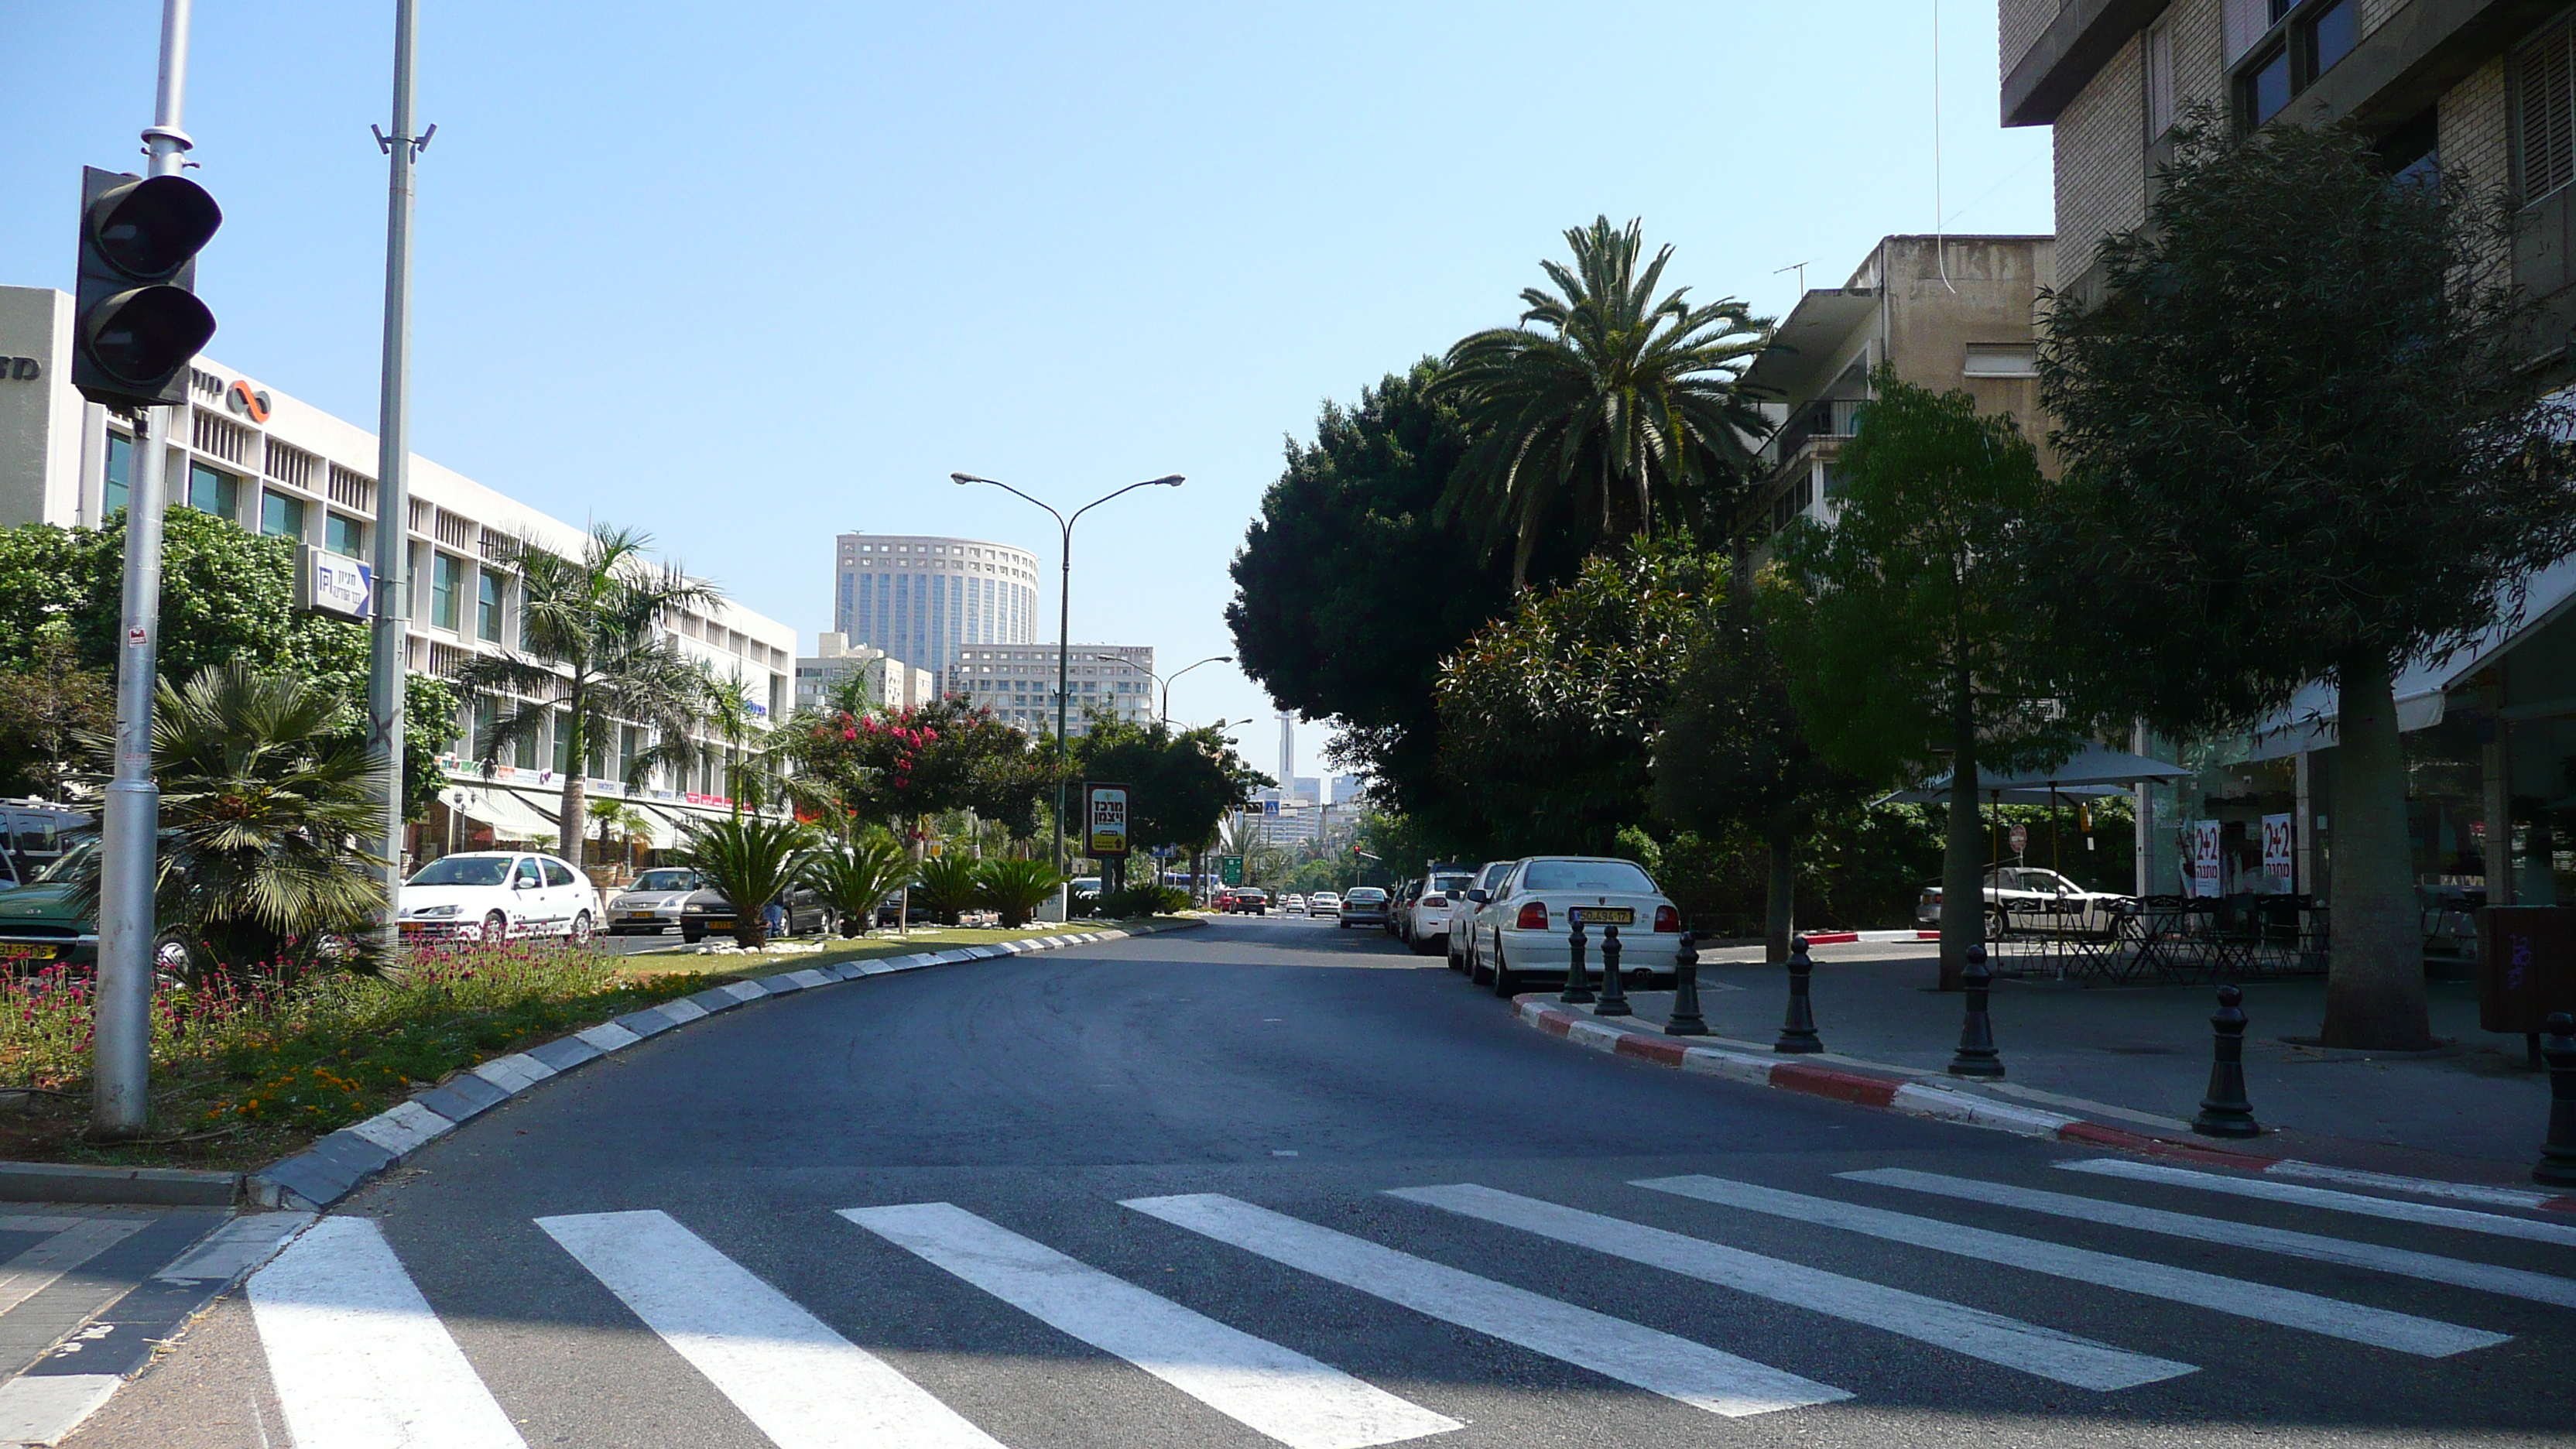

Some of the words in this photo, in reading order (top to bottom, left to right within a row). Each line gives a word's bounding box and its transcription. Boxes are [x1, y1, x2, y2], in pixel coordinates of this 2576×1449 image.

[338, 570, 356, 587] חניון
[1094, 801, 1124, 812] מרכז
[1094, 812, 1124, 825] ויצמן
[2196, 827, 2218, 861] 2+2
[2264, 821, 2290, 858] 2+2
[2197, 865, 2218, 879] מתנה
